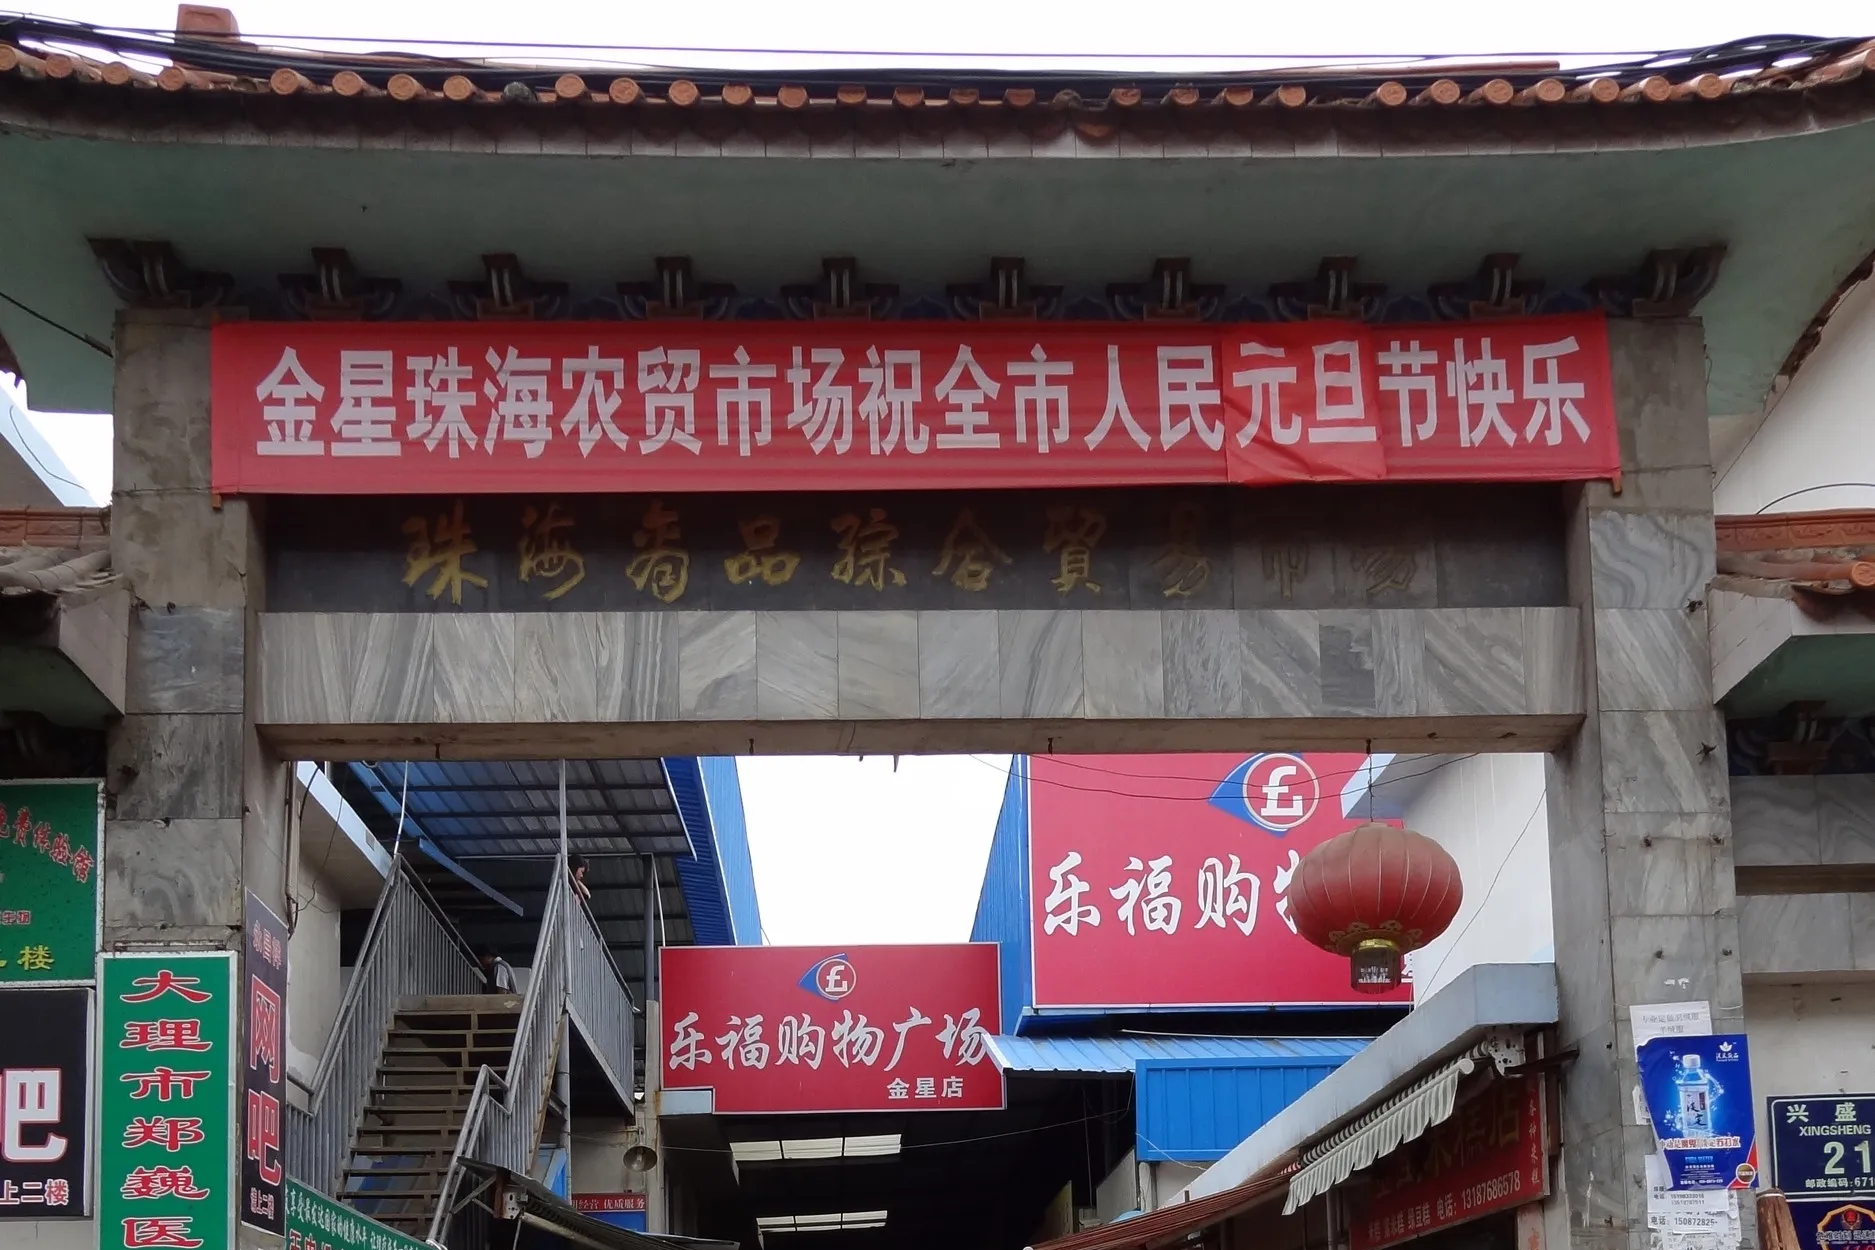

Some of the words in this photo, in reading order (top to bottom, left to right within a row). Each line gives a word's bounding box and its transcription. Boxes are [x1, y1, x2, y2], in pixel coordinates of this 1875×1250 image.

[255, 336, 1591, 458] 金星珠海农贸市场祝全市人民元旦节快乐
[668, 1006, 991, 1072] 乐福购物广场
[247, 973, 282, 1187] 网吧
[886, 1076, 964, 1099] 金星店
[1799, 1124, 1872, 1136] XINGSHENG
[1823, 1140, 1871, 1175] 21
[1805, 1176, 1875, 1188] 邮政编码:671
[604, 1198, 645, 1210] 优质服务
